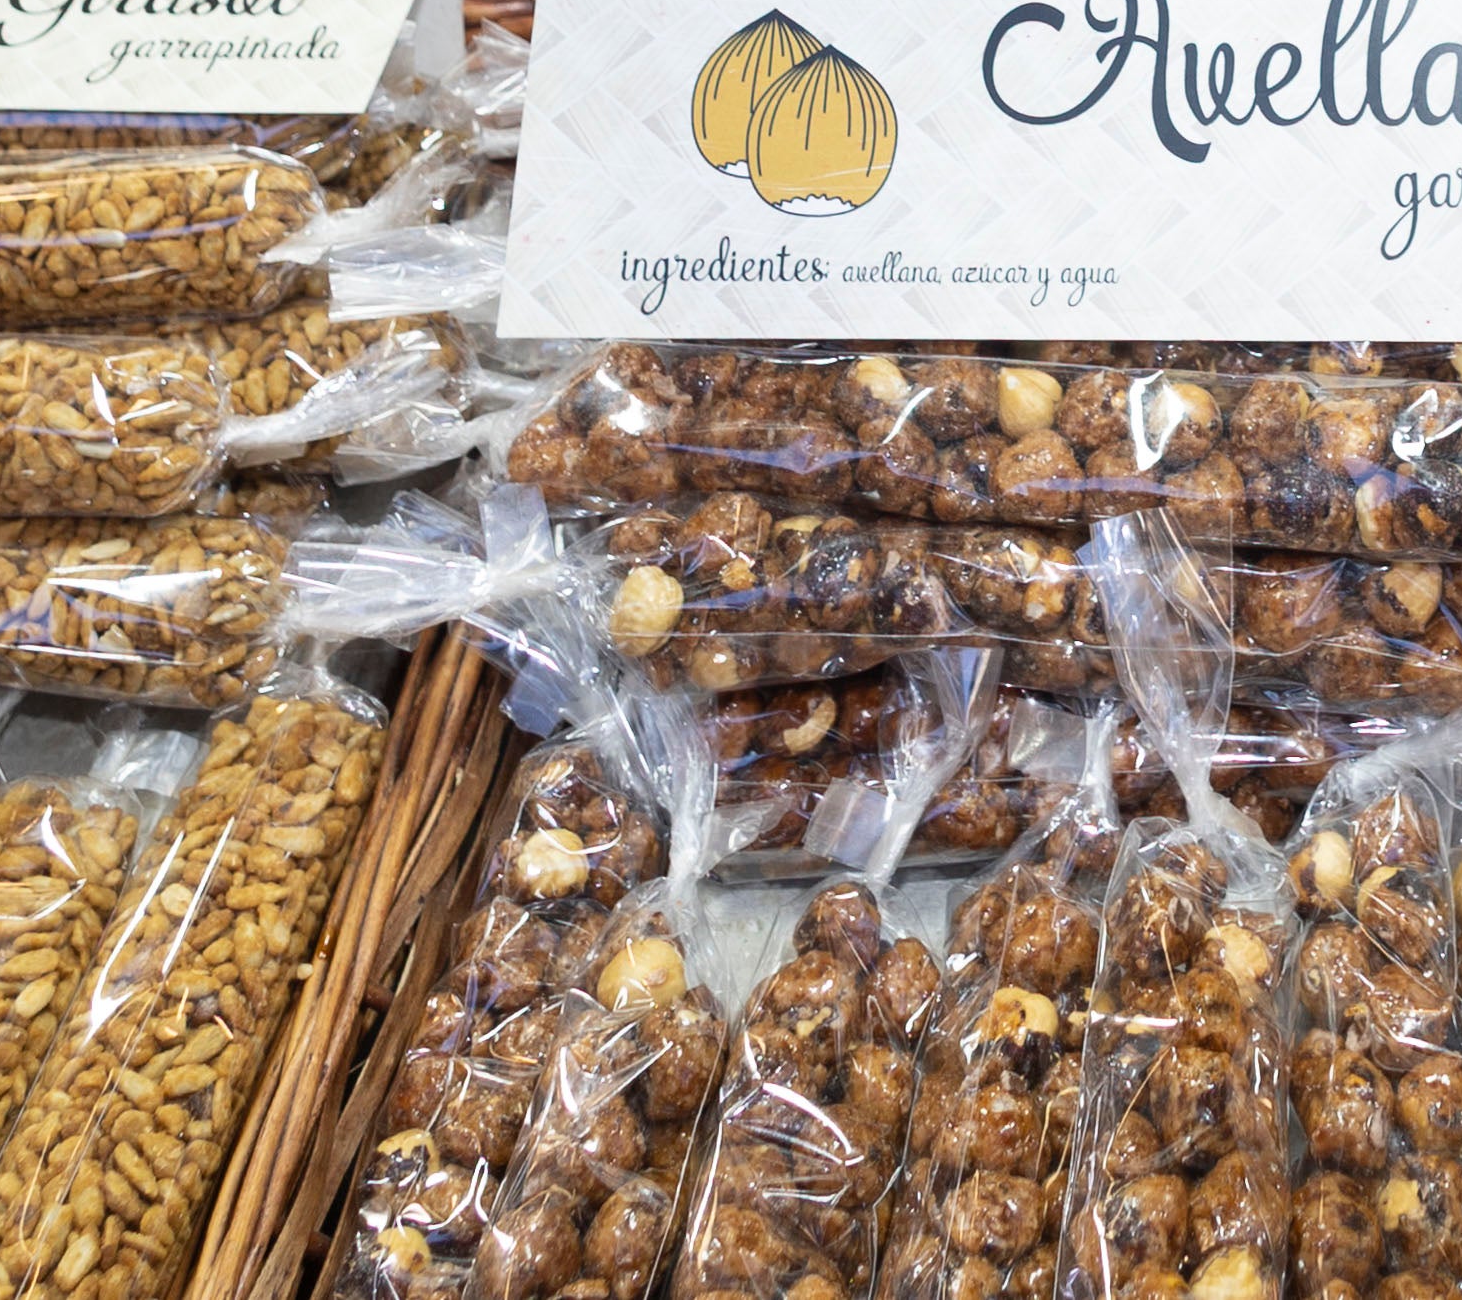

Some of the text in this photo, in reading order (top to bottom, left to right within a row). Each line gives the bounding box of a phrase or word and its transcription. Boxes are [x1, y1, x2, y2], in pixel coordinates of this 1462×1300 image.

[621, 235, 830, 317] ingredientes:
[1029, 267, 1051, 308] y
[1059, 267, 1122, 308] agua
